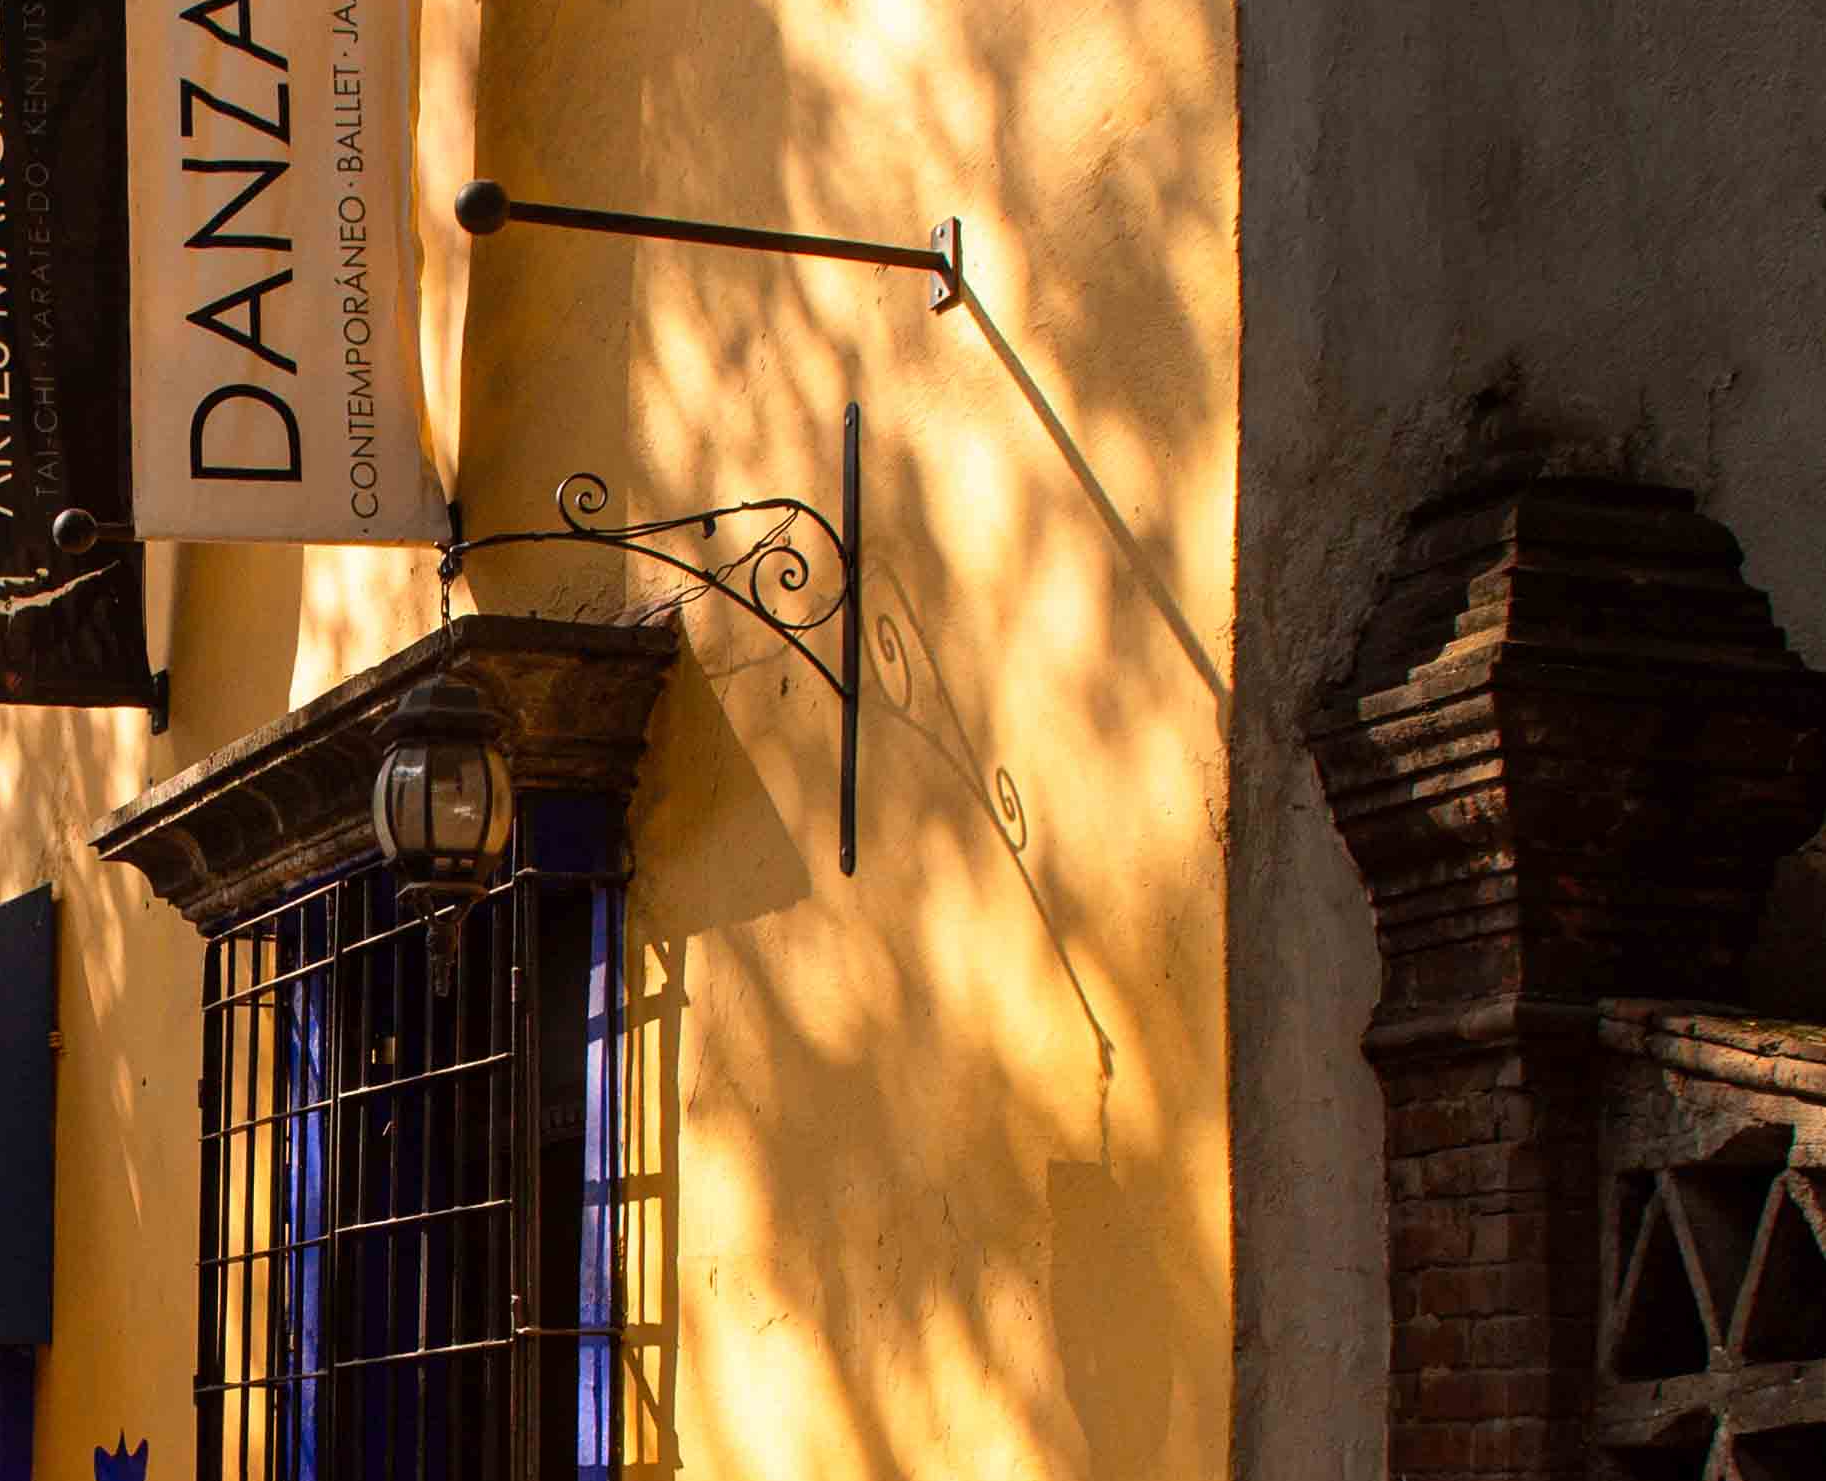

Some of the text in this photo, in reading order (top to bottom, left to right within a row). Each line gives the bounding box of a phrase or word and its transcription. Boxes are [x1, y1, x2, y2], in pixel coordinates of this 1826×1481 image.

[335, 63, 364, 173] BALLET
[23, 161, 54, 348] KARATE-DO
[333, 194, 378, 520] CONTEMPORÁNEO
[34, 375, 63, 498] TAI-CHI
